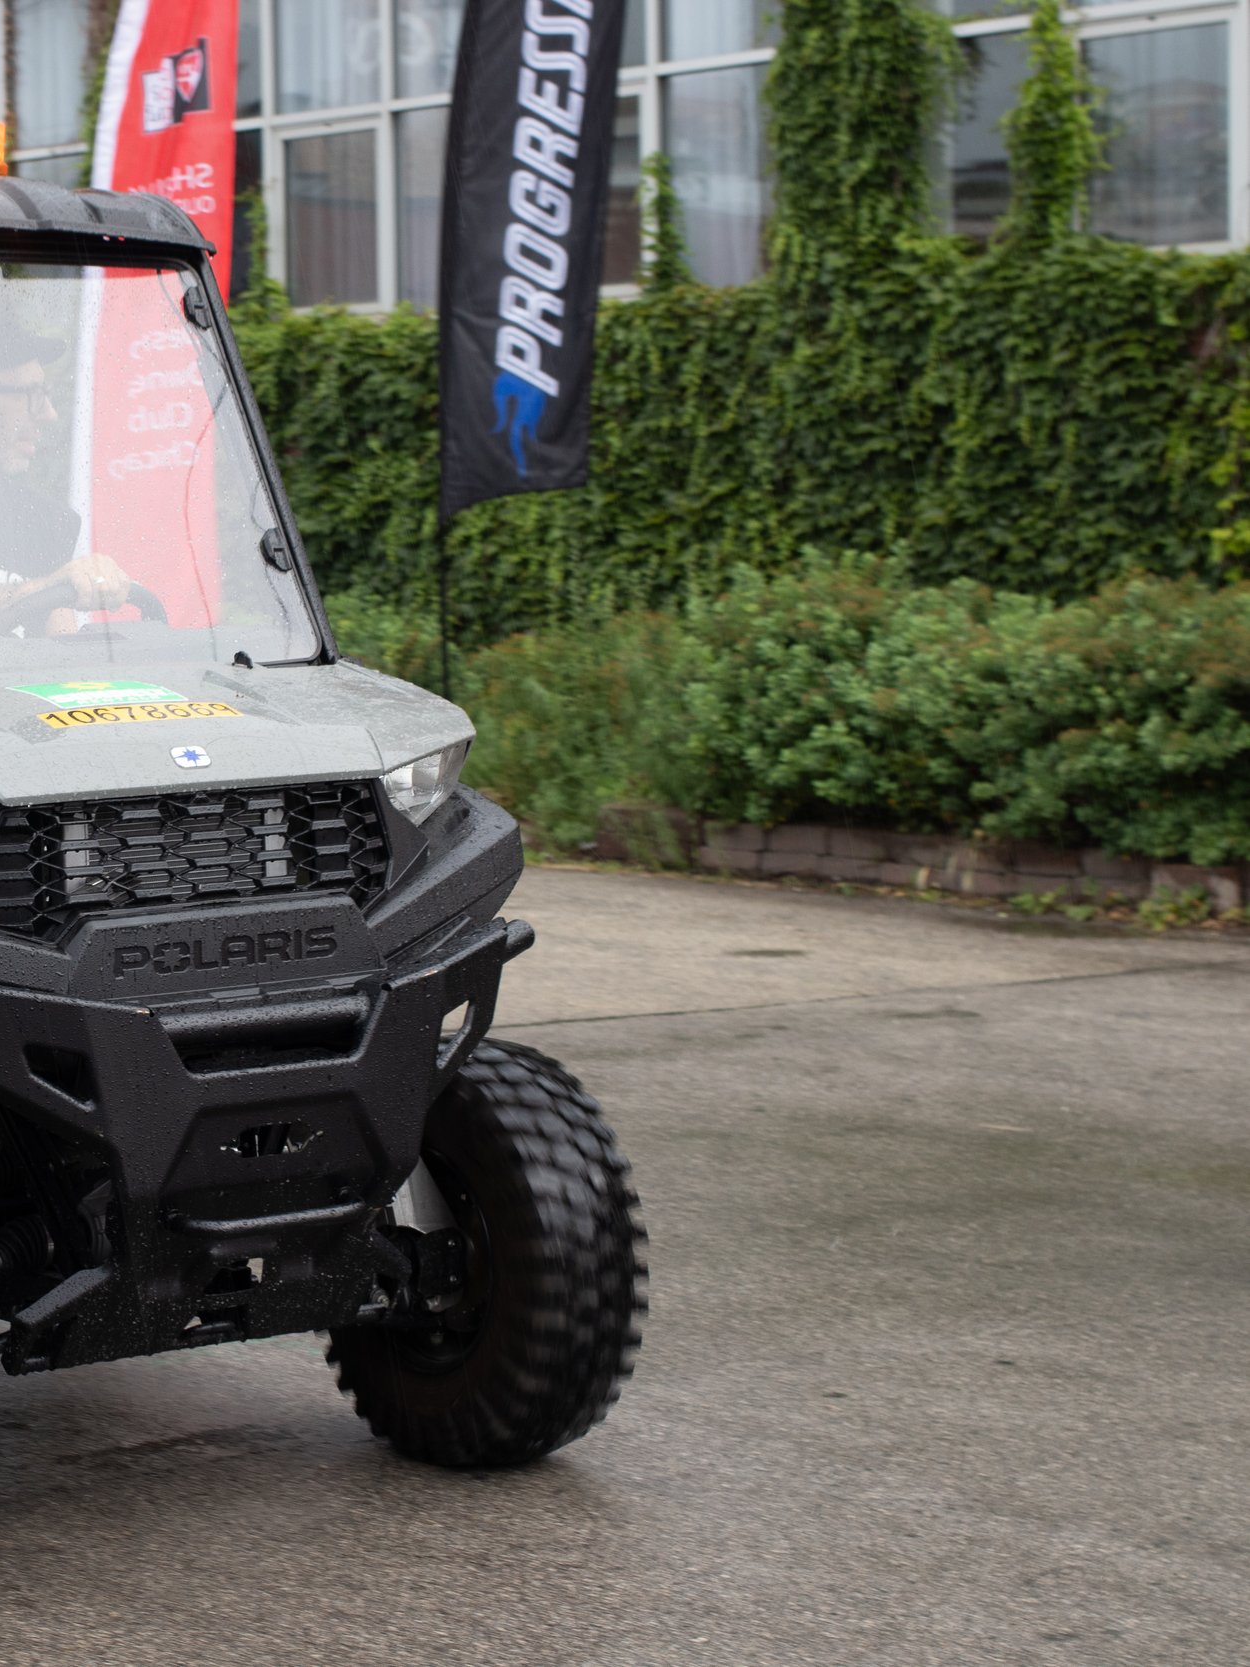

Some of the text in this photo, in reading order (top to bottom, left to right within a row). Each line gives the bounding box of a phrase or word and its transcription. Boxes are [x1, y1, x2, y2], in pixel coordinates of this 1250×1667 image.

[495, 0, 593, 397] PROGRESS
[44, 703, 239, 727] 10678669
[113, 926, 338, 980] POLARIS
